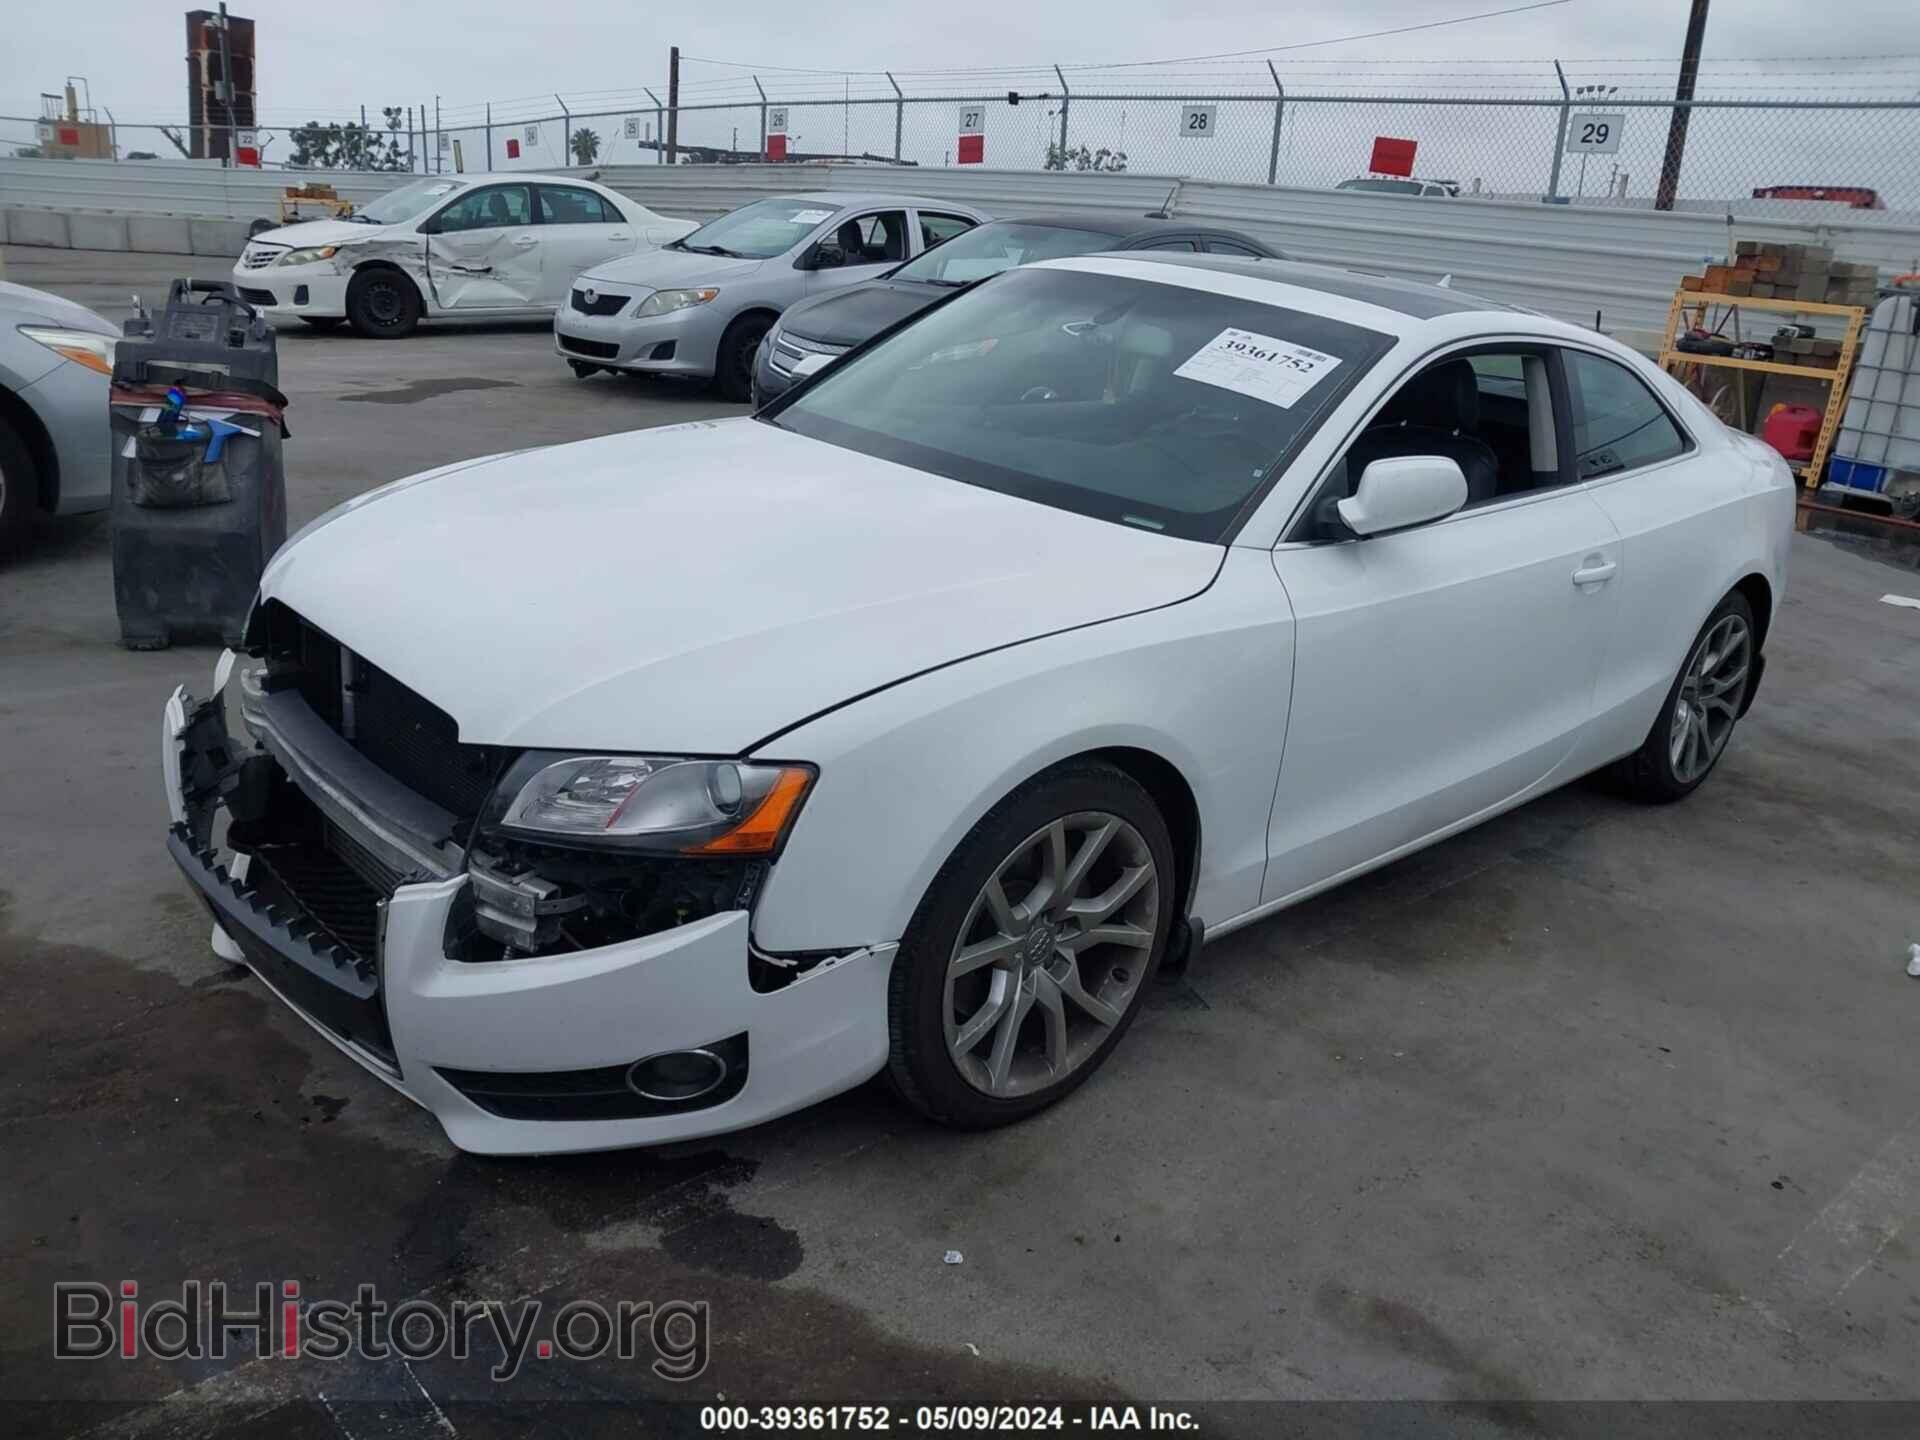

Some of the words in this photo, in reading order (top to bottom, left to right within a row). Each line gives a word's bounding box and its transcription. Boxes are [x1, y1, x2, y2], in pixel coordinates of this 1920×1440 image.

[773, 113, 784, 127] 26
[965, 112, 979, 128] 27
[1189, 112, 1208, 130] 28
[1580, 123, 1610, 144] 29
[1219, 340, 1315, 373] 39361752
